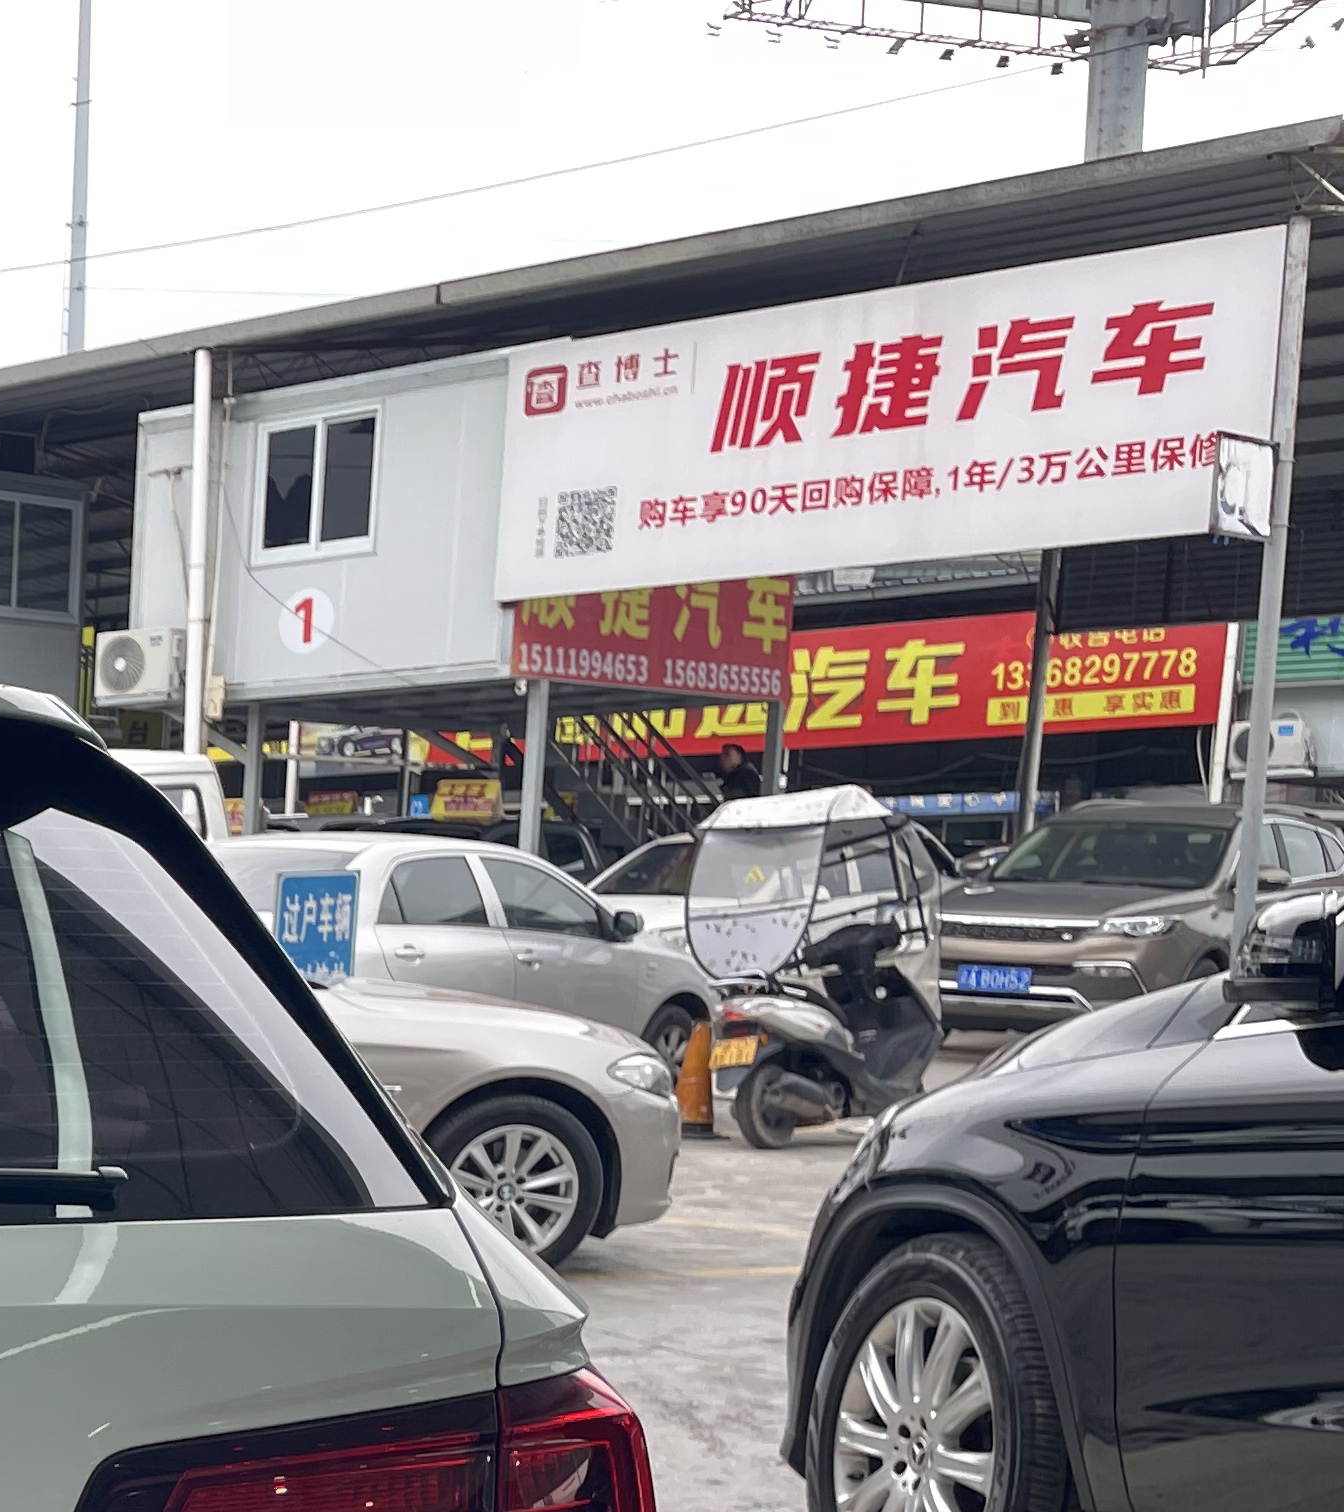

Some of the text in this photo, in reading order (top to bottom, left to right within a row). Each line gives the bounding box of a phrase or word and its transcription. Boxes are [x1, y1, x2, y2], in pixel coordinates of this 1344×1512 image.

[709, 300, 1215, 454] 顺捷汽车
[294, 597, 314, 643] 1
[518, 642, 782, 697] 15111994653 15683655556
[991, 647, 1198, 692] 1368297778
[282, 892, 353, 943] 过户车辆
